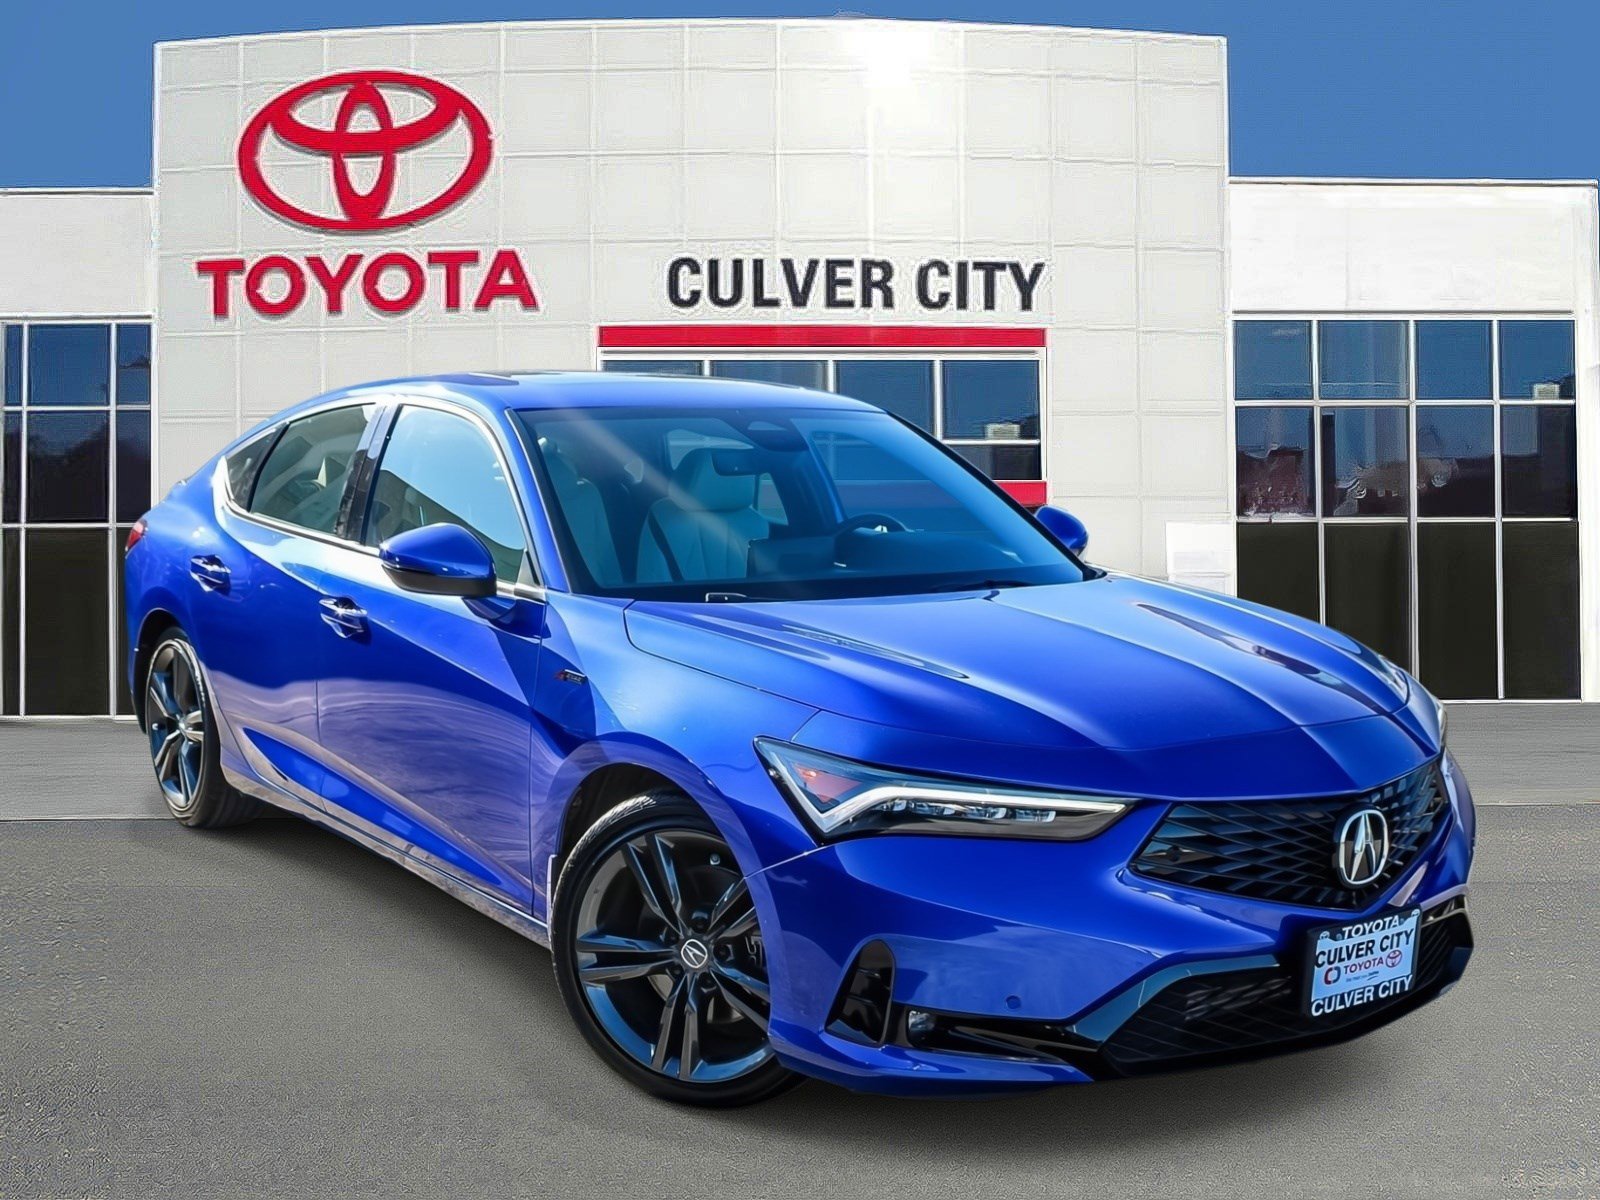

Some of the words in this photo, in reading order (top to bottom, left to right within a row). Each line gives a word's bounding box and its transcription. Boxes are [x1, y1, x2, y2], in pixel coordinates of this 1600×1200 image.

[195, 249, 539, 317] TOYOTA
[667, 257, 895, 309] CULVER
[916, 259, 1045, 311] CITY
[1315, 939, 1375, 968] CULVER
[1380, 928, 1414, 953] CITY
[1342, 915, 1400, 940] TOYOTA
[1343, 956, 1384, 975] TOYOTA
[1311, 987, 1374, 1016] CULVER
[1378, 974, 1413, 998] CITY
